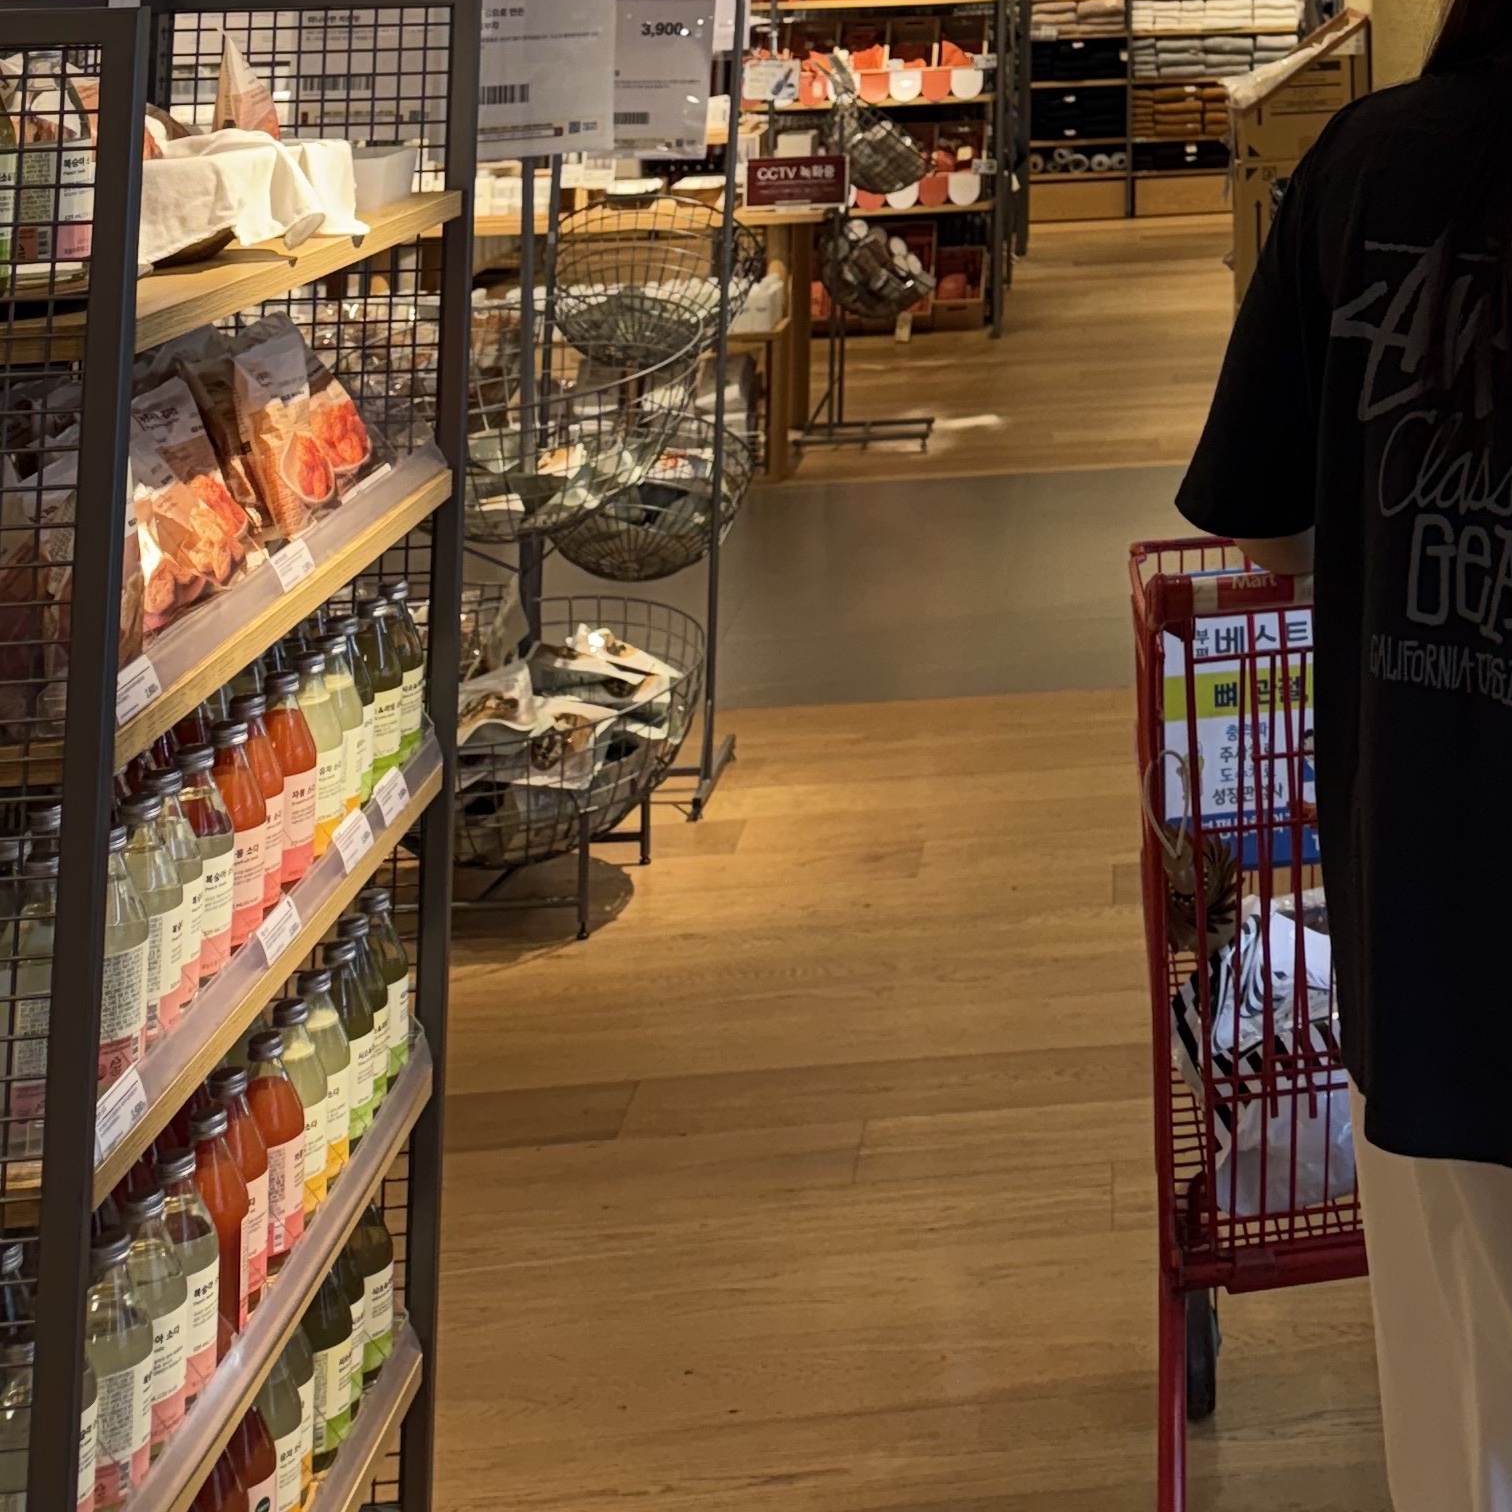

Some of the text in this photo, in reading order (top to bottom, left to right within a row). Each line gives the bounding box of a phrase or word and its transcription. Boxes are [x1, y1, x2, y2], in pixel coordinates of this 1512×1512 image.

[641, 21, 683, 37] 3,900
[757, 166, 797, 181] CCTV
[1232, 572, 1278, 589] Mart
[1214, 620, 1309, 654] 베스트
[1369, 633, 1475, 692] CALIFORNIA
[1214, 681, 1238, 709] 뼈
[247, 842, 259, 856] 소다
[205, 868, 227, 884] 복숭아
[327, 1086, 340, 1099] 소다
[305, 1119, 318, 1132] 소다
[166, 1324, 181, 1341] 소다
